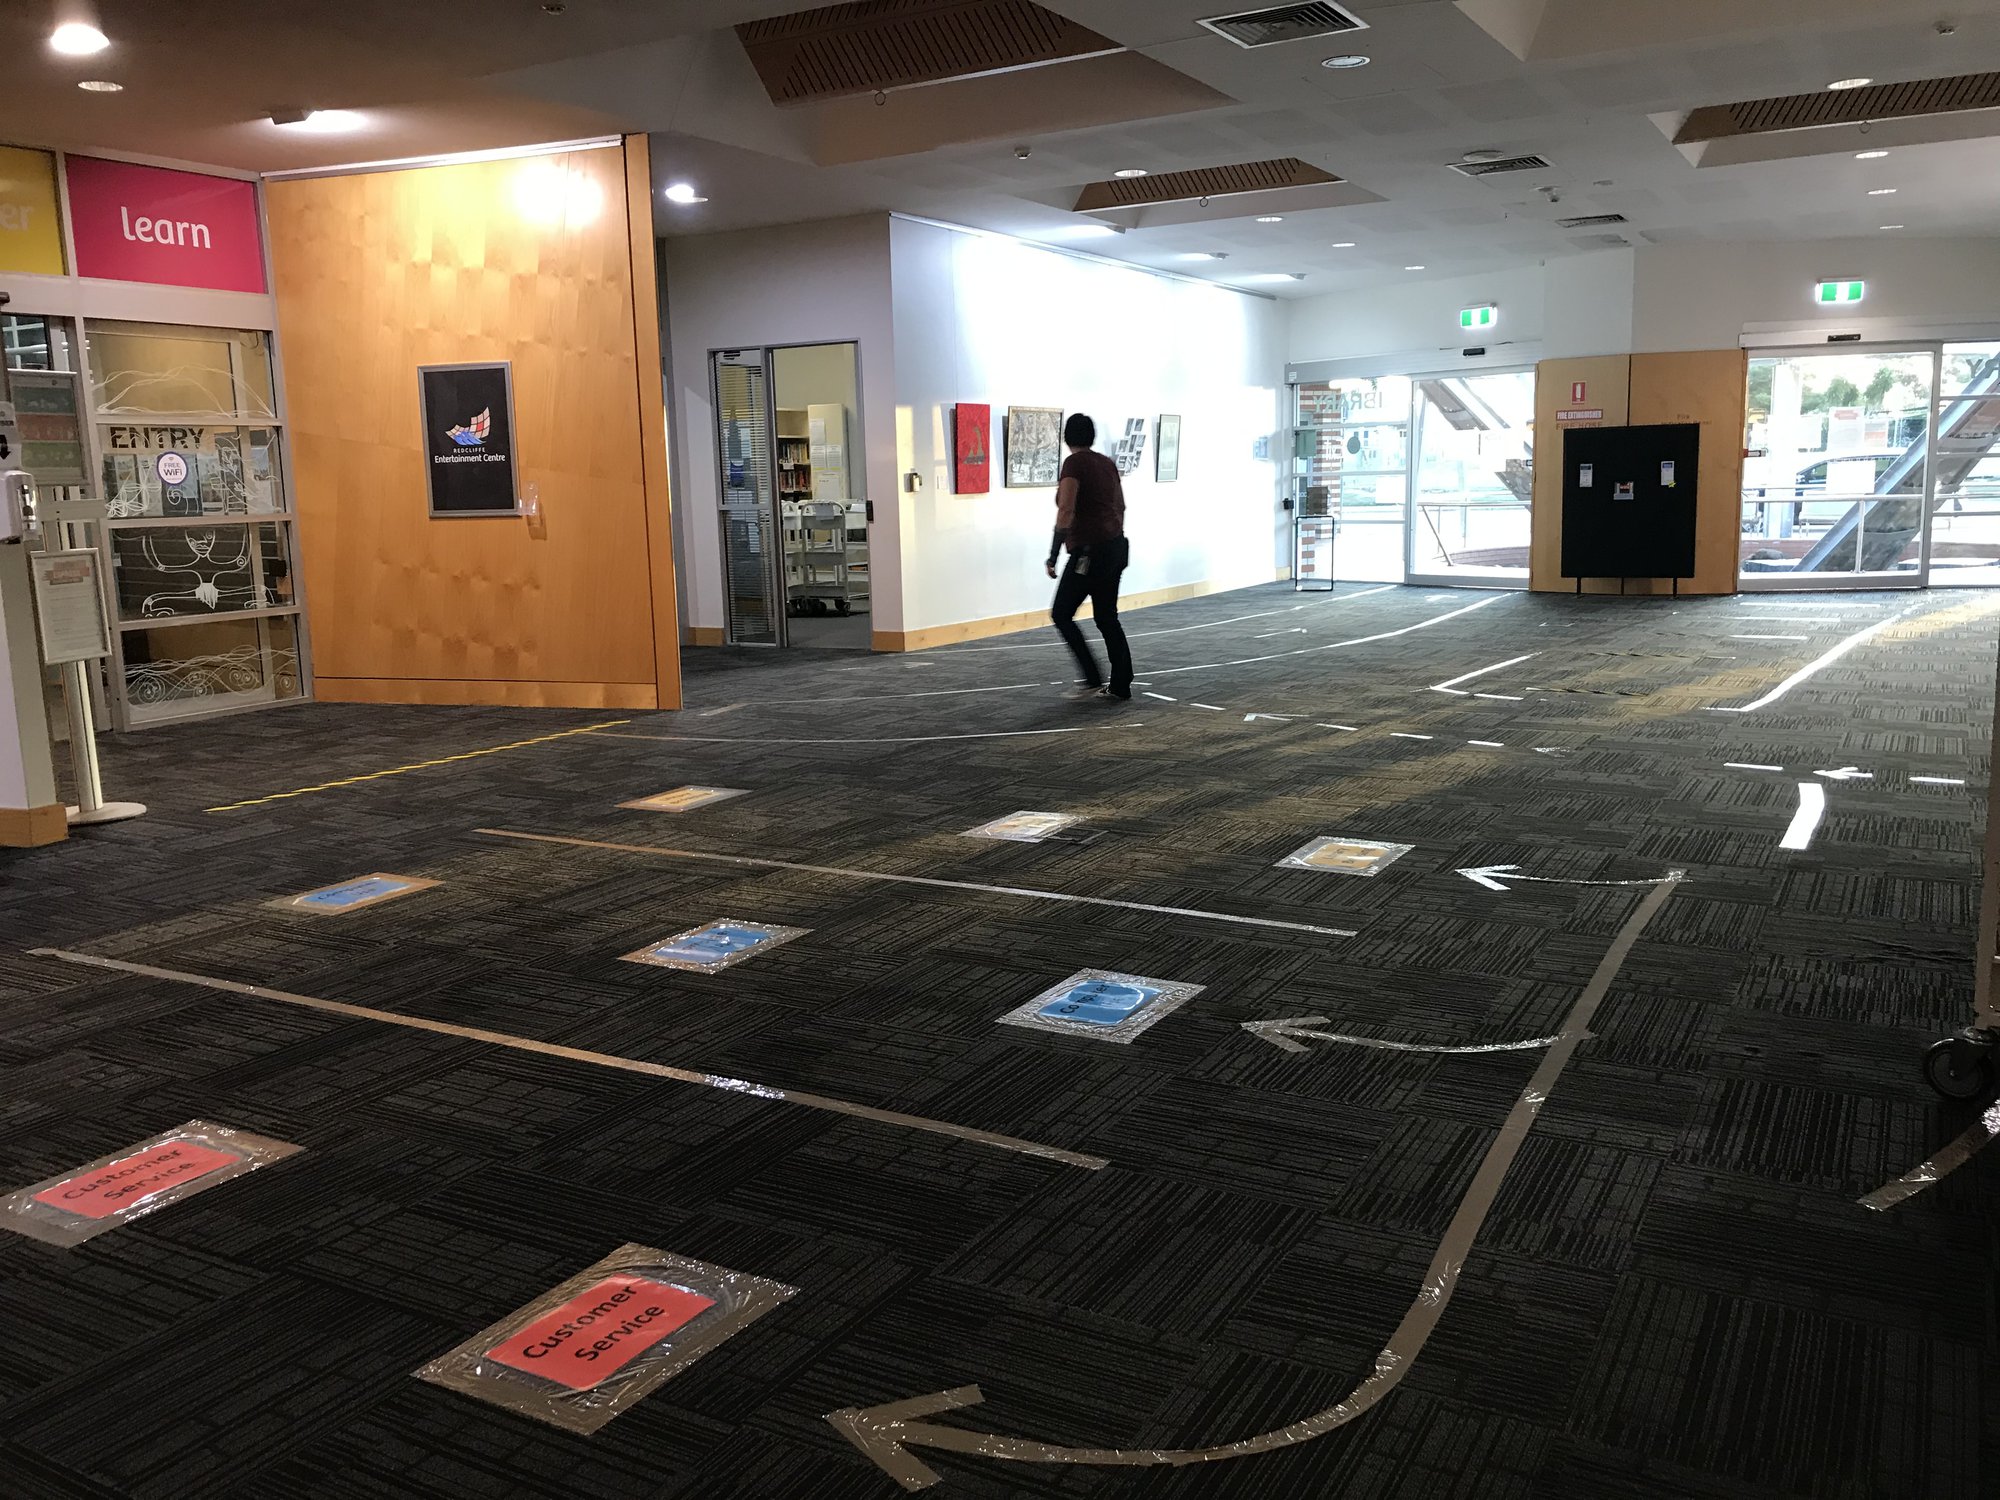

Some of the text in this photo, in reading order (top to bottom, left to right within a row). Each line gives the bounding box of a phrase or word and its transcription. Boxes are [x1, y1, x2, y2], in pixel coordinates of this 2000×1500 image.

[120, 206, 212, 249] learn
[1557, 411, 1568, 420] FIRE
[109, 426, 205, 449] ENTRY
[434, 454, 506, 463] Entertainment Centre
[61, 1148, 183, 1201] Customer
[103, 1160, 196, 1201] Service
[522, 1284, 638, 1361] Customer
[574, 1303, 666, 1362] Service
